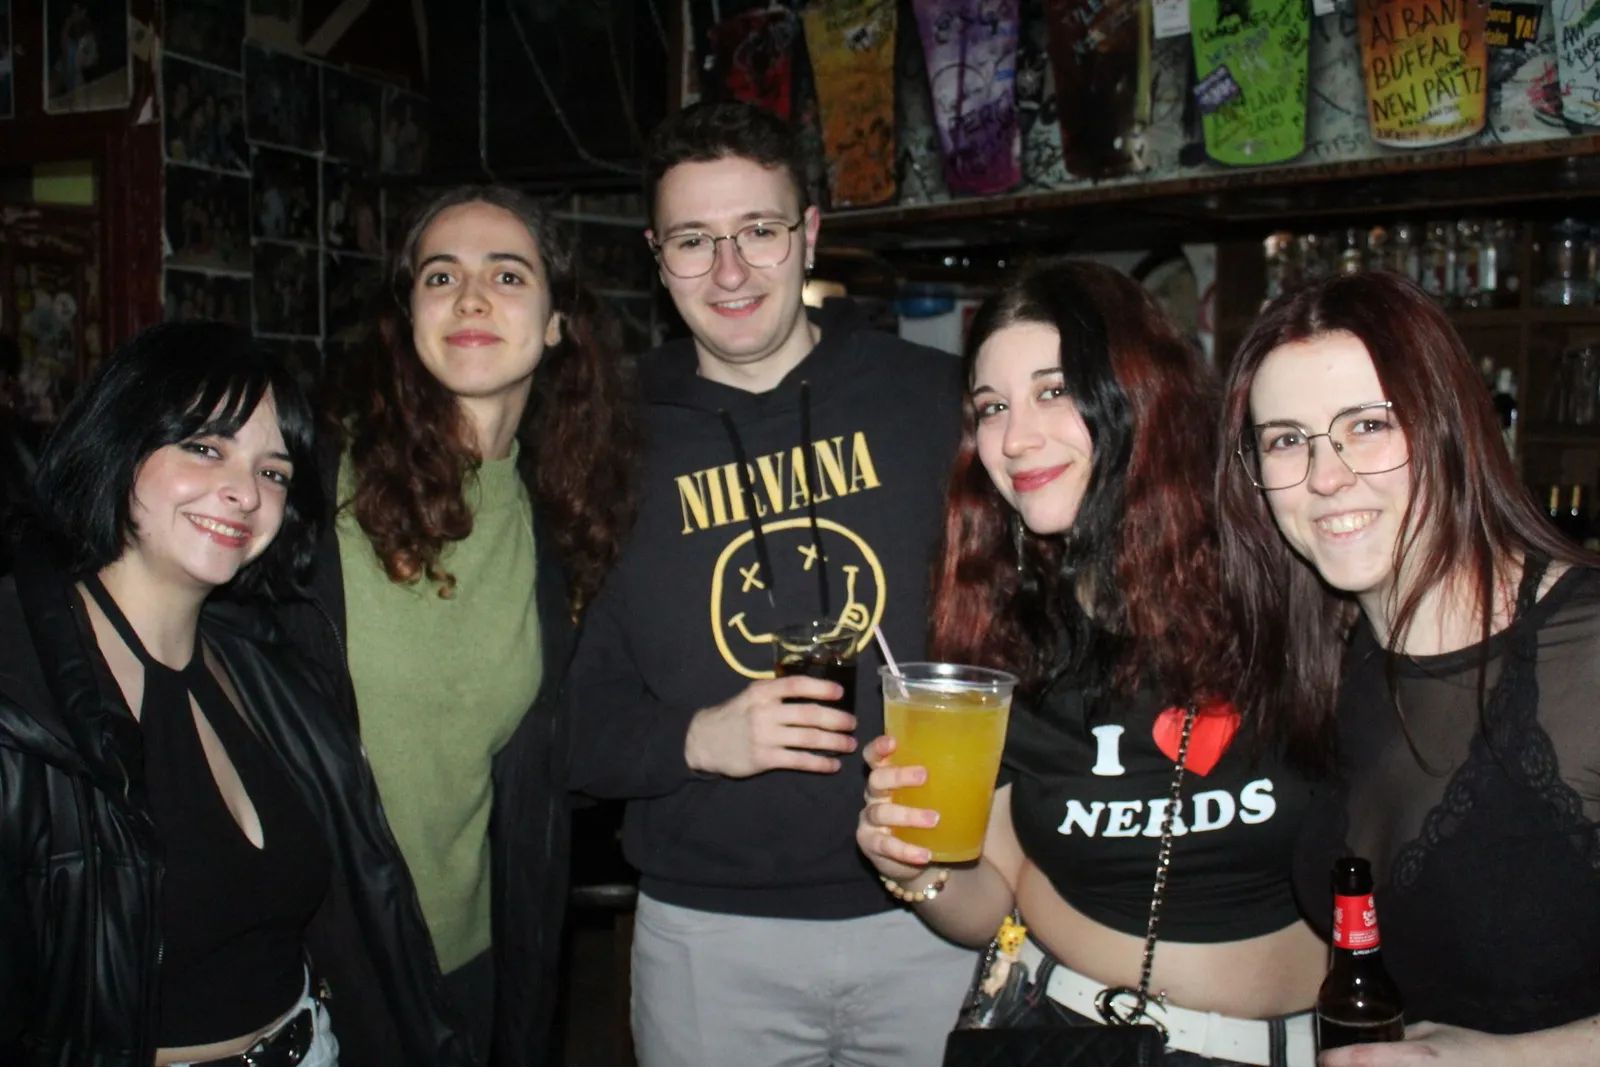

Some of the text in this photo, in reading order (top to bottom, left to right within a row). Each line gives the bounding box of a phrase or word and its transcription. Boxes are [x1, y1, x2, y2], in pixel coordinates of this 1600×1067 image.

[1372, 30, 1472, 91] BUFFALO
[1372, 83, 1418, 122] NEW
[674, 431, 881, 535] NIRVANA
[1091, 724, 1125, 776] I
[1057, 778, 1276, 837] NERDS
